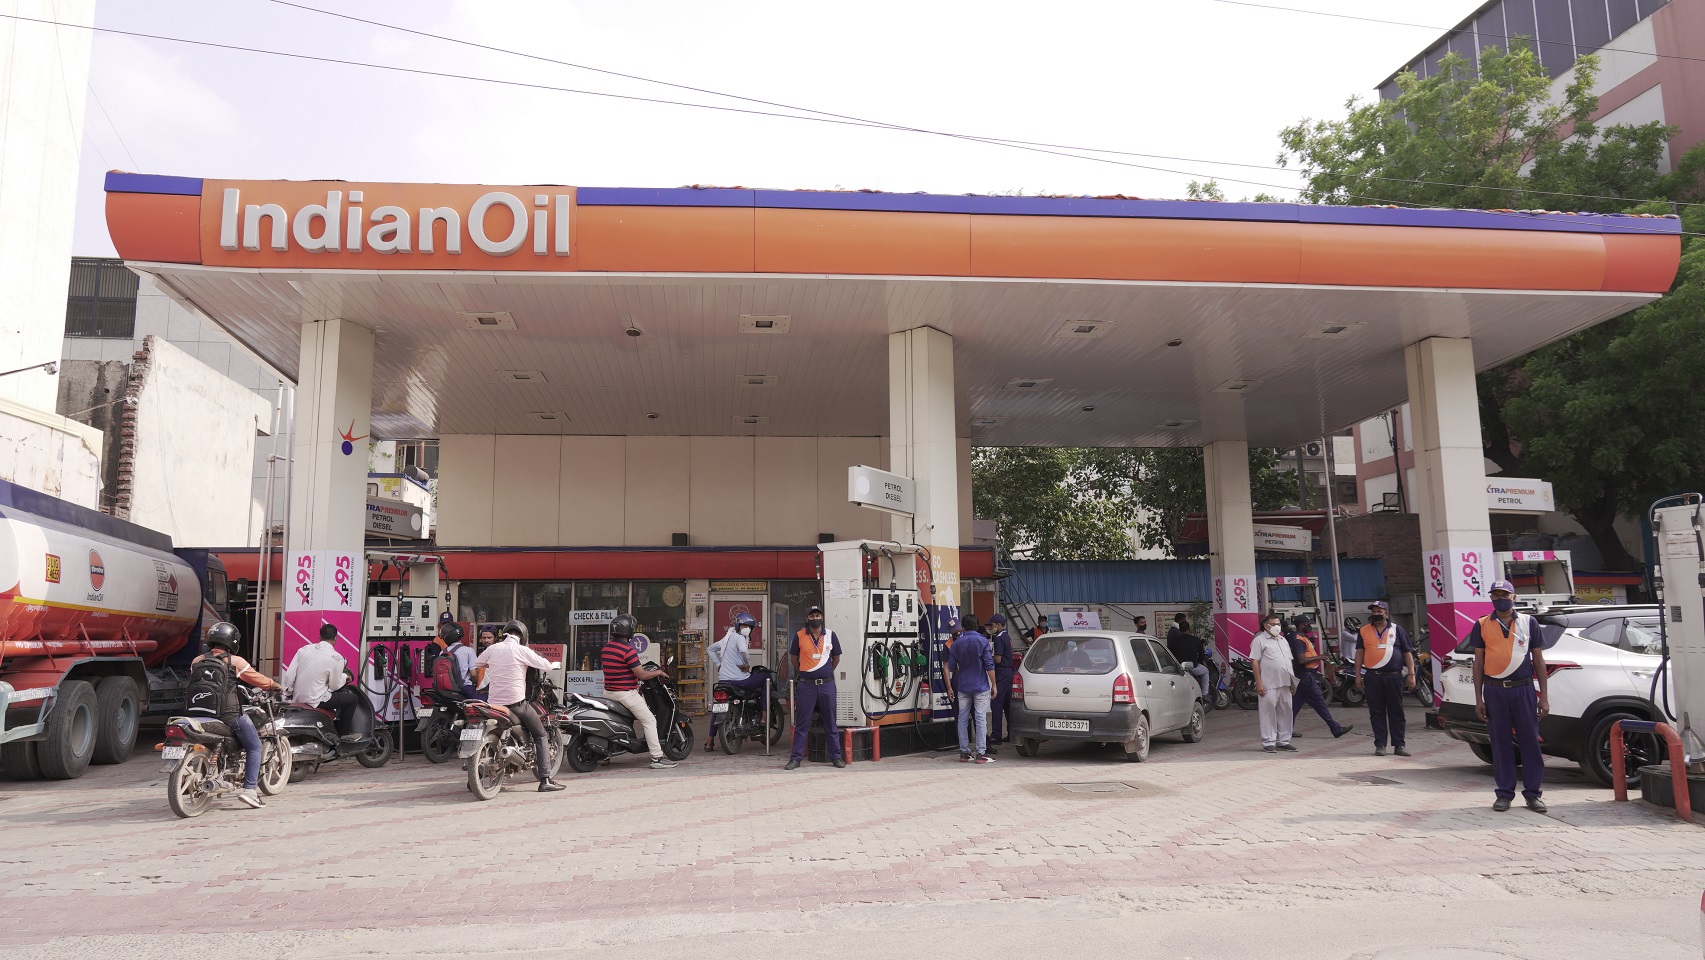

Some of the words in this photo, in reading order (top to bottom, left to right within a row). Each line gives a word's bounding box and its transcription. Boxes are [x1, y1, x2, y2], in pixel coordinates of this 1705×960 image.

[220, 188, 570, 256] IndianOil
[884, 482, 903, 493] PETROL
[885, 492, 903, 503] DIESEL
[366, 502, 408, 517] TRAPREMIUM
[372, 513, 394, 523] PETROL
[372, 521, 393, 531] DIESEL
[932, 554, 942, 569] GO
[295, 555, 312, 606] XP95
[334, 555, 351, 606] XP95
[1429, 553, 1444, 599] XP95
[1461, 551, 1481, 597] XP95
[1233, 577, 1247, 610] XP95
[573, 612, 594, 620] CHECK
[594, 612, 600, 620] &
[600, 612, 613, 620] FILL
[633, 637, 643, 652] पे
